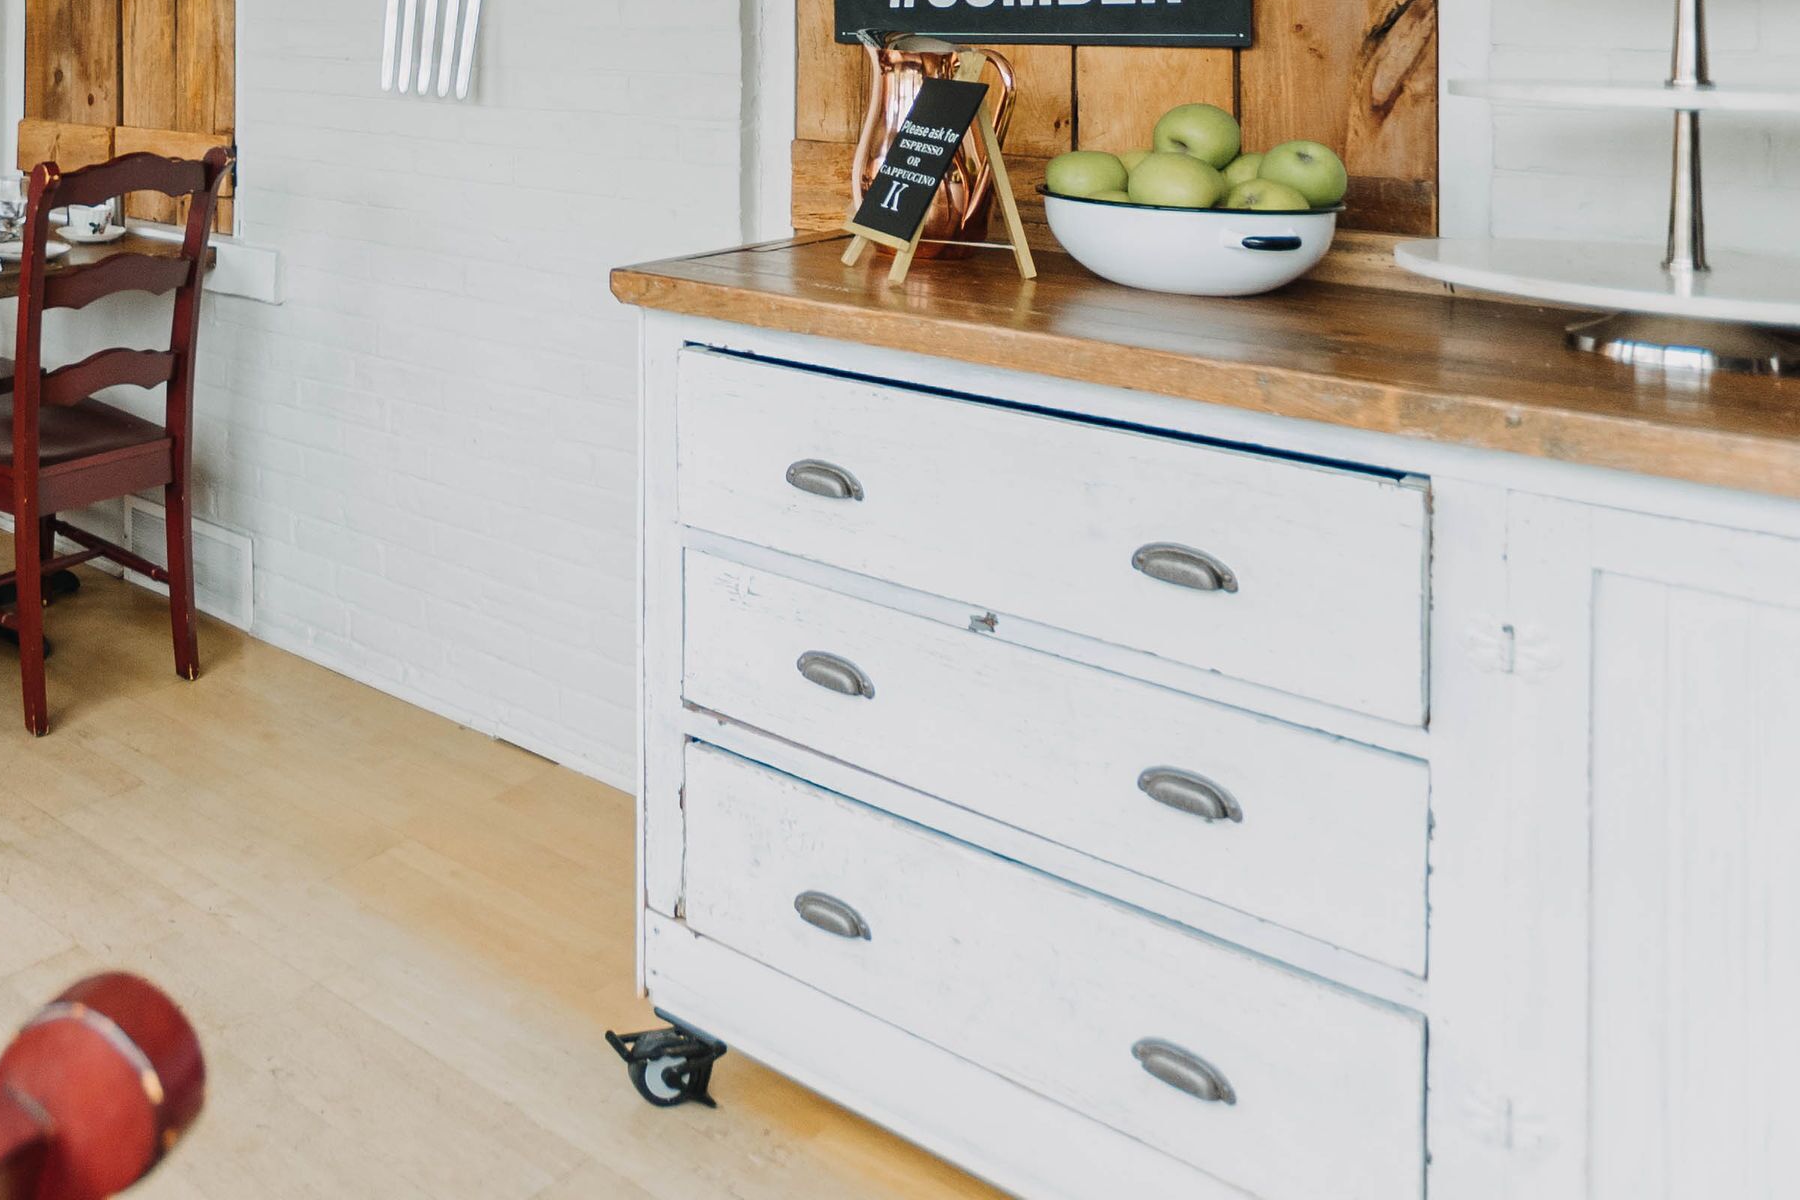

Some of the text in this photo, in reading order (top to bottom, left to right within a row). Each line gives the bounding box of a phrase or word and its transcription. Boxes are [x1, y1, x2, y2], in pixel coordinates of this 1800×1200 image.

[928, 126, 945, 141] ask
[944, 128, 959, 143] for
[900, 138, 943, 156] ESPRESSO
[906, 155, 921, 167] OR
[880, 164, 936, 187] CAPPUCCINO
[880, 180, 909, 212] K
